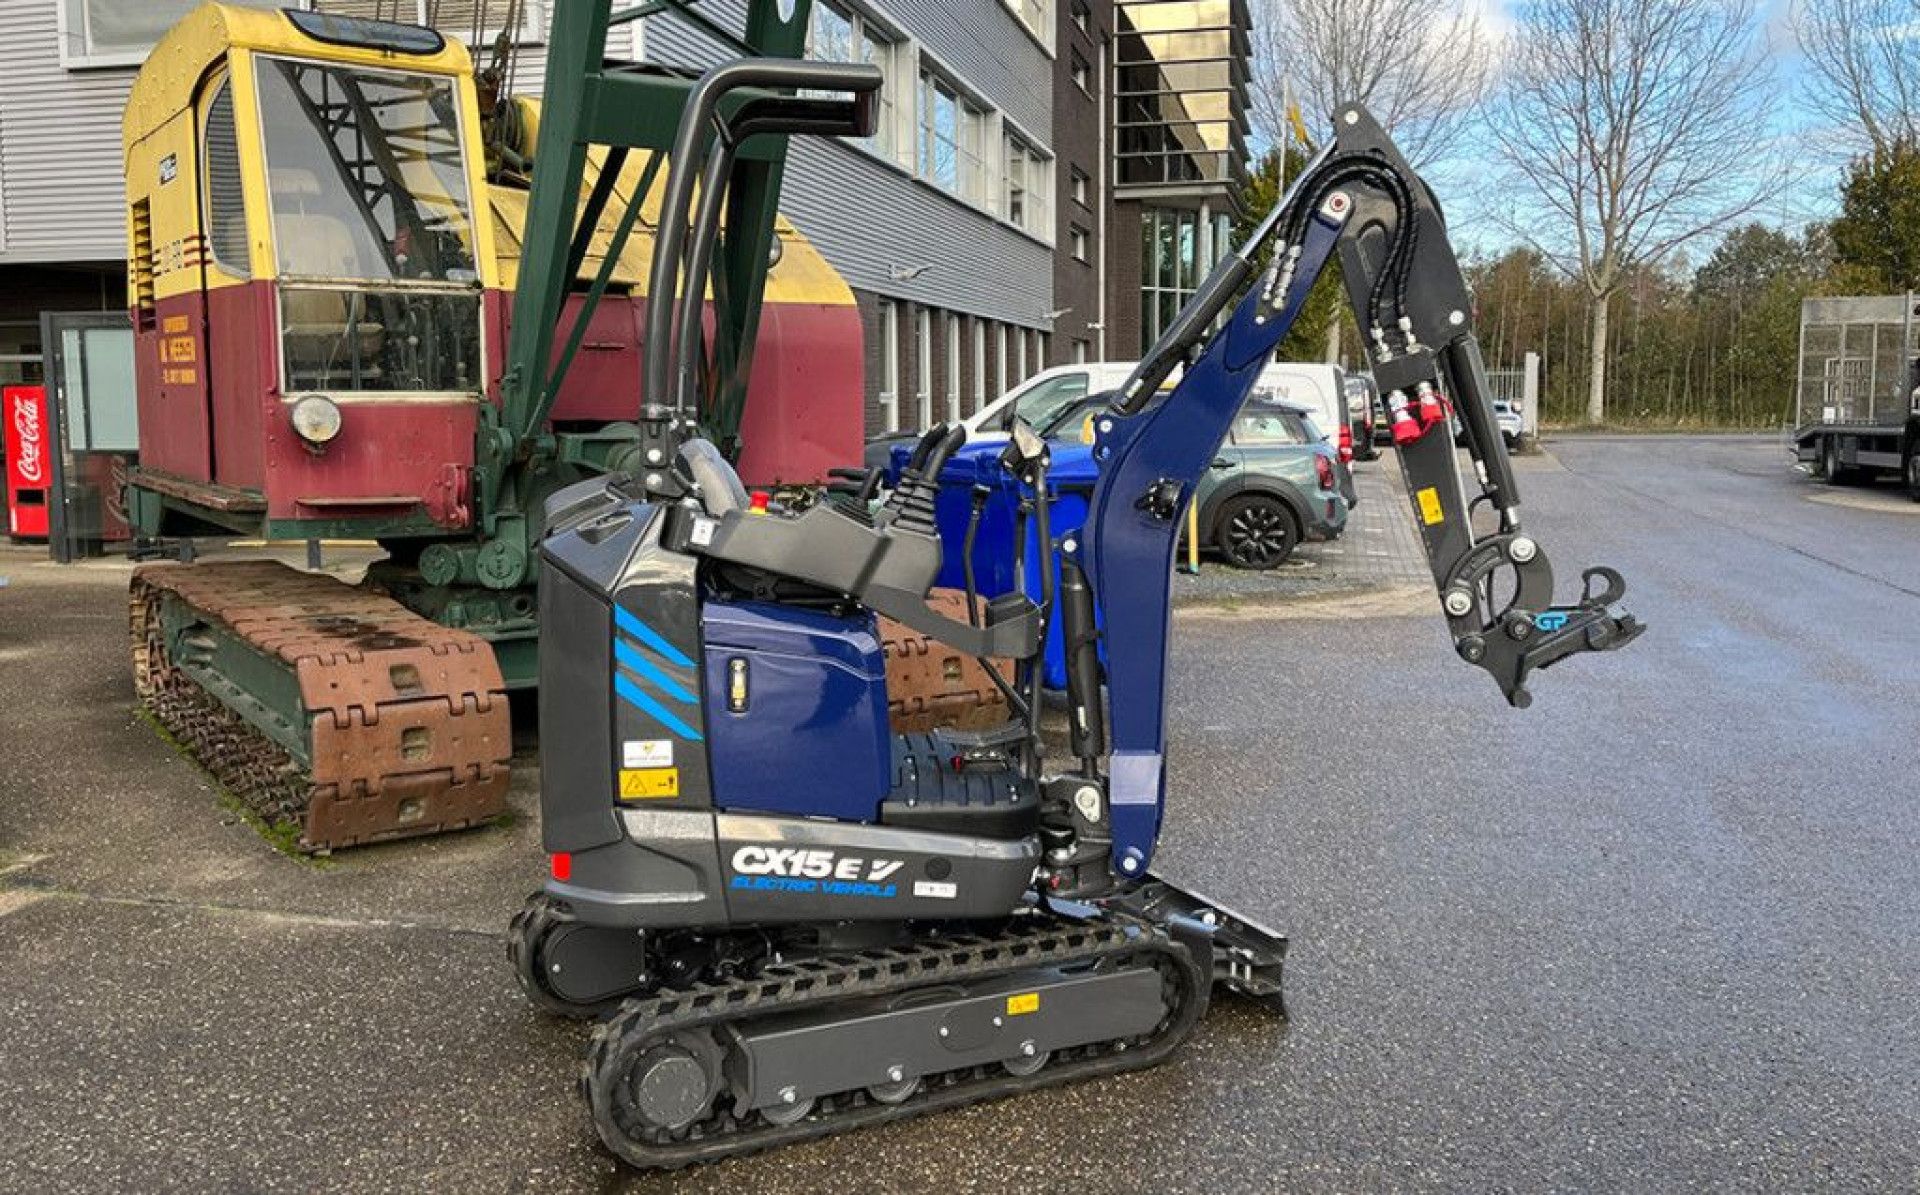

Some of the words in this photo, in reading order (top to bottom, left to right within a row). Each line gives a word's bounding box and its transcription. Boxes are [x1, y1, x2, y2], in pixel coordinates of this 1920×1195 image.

[731, 845, 835, 879] CX15
[730, 873, 816, 894] ELECTRIC
[822, 880, 897, 898] VEHICLE
